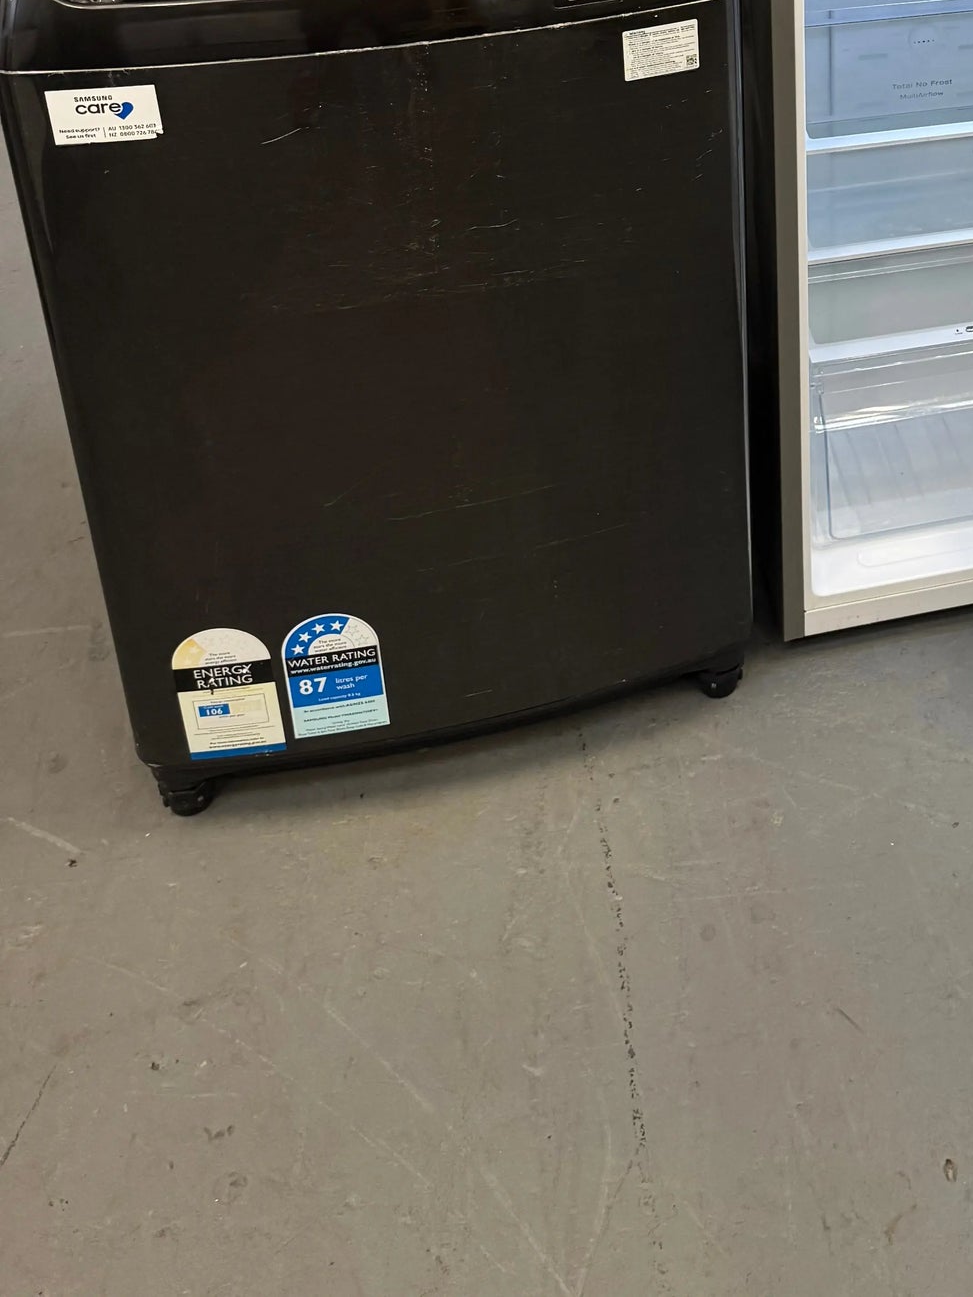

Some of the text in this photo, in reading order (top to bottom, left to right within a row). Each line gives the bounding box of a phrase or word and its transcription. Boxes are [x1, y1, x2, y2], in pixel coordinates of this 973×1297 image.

[74, 95, 113, 103] SAMSUNG
[75, 102, 122, 115] care
[288, 648, 376, 669] WATER RATING
[193, 663, 253, 679] ENERGY
[197, 674, 253, 689] RATING
[299, 677, 327, 696] 87
[205, 708, 223, 716] 106
